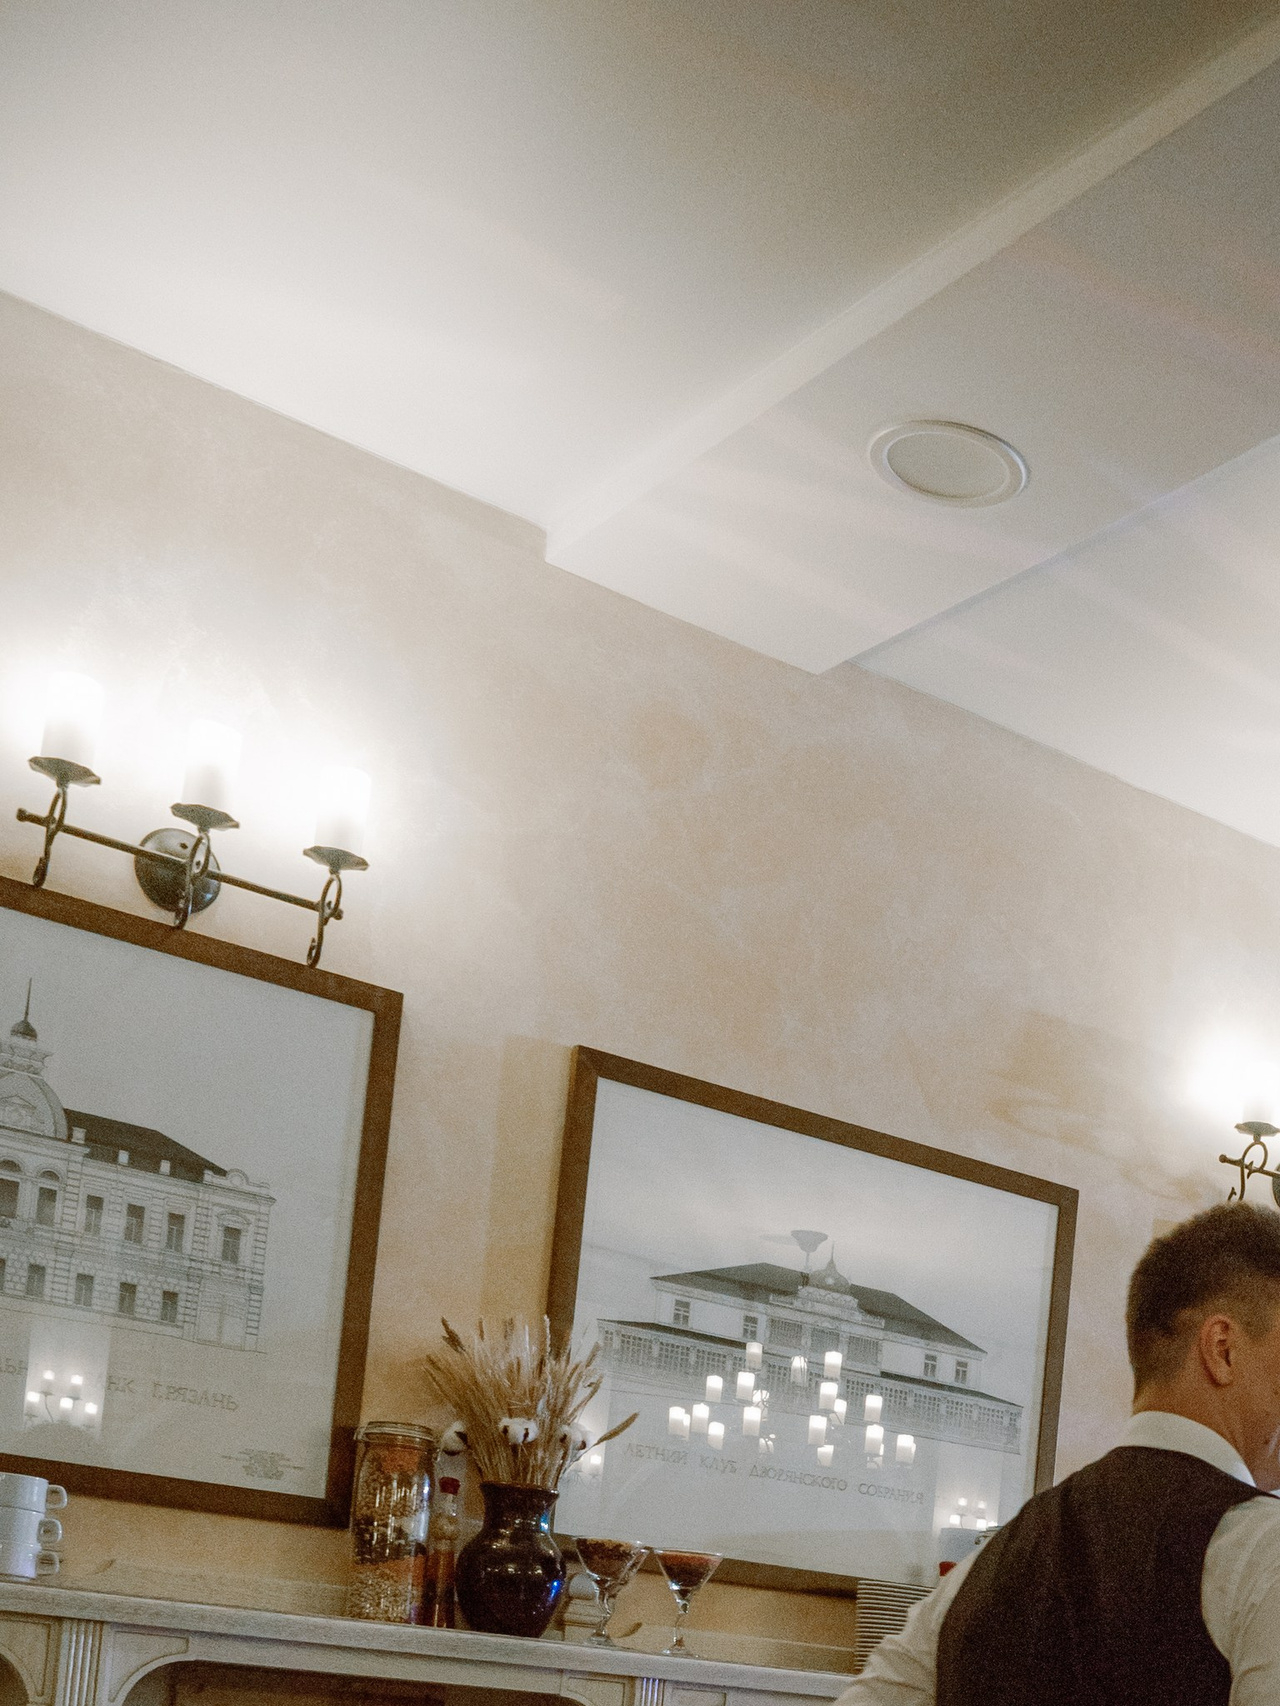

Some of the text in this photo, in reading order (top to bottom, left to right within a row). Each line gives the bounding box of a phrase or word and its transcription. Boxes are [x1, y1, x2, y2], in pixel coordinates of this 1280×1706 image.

[699, 1454, 738, 1474] КЛУБ
[749, 1464, 848, 1492] ДВОРЯНСКОГО
[858, 1482, 925, 1505] СОБРАНИЯ
